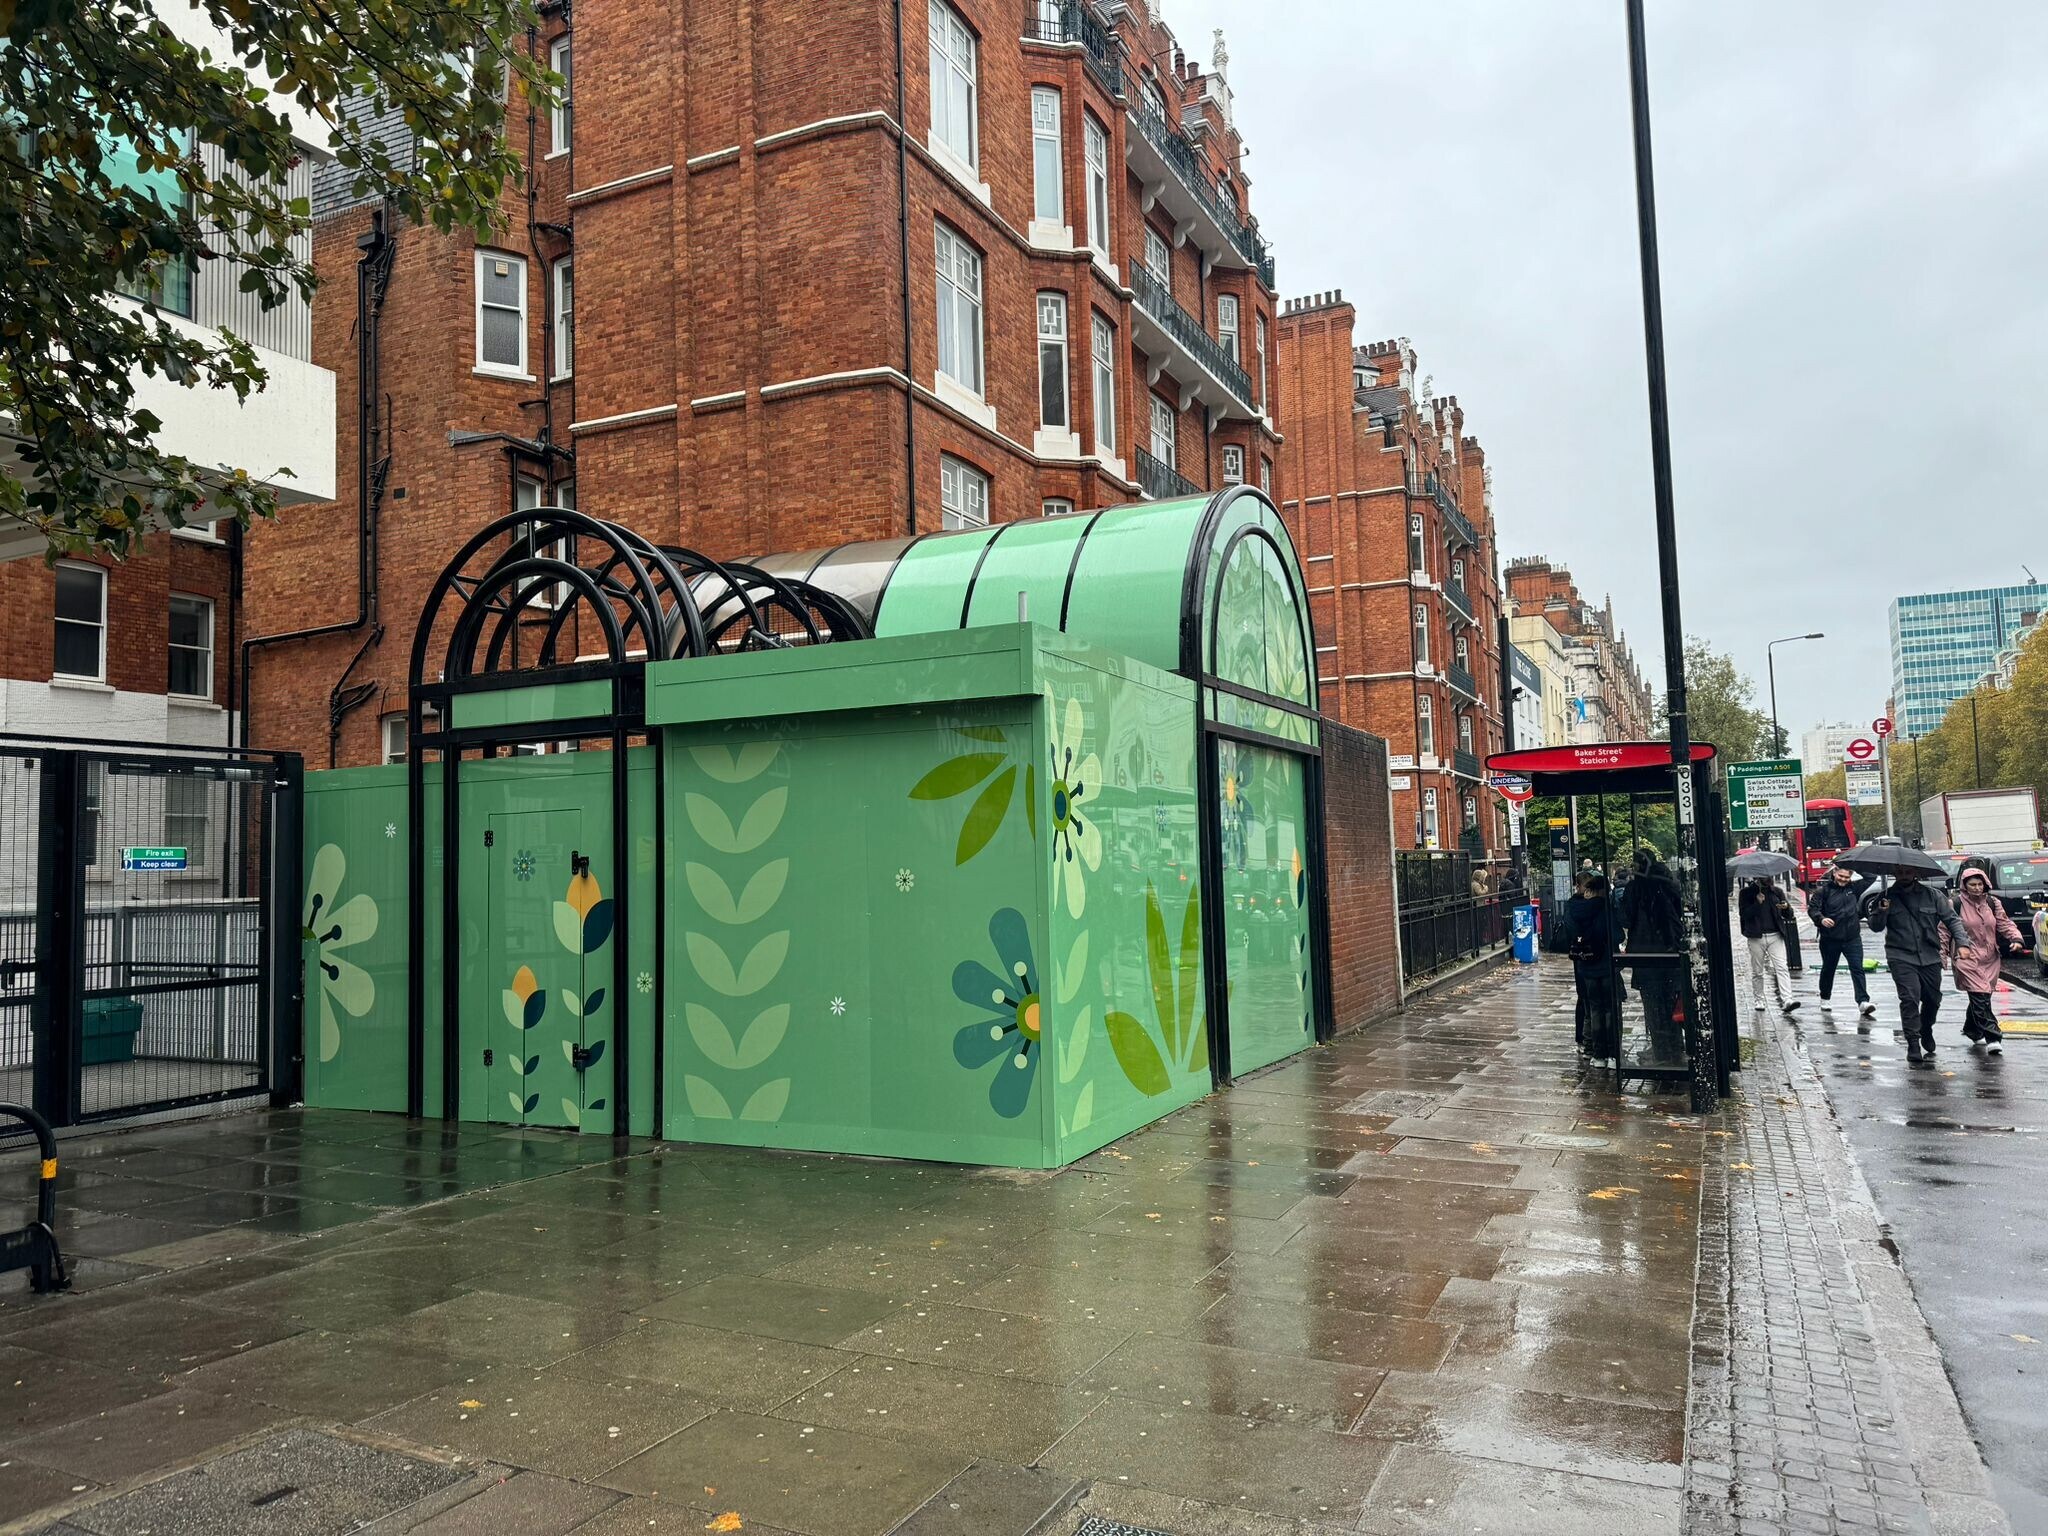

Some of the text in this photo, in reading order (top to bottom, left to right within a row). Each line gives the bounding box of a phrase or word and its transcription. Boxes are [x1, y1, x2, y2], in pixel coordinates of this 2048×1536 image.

[1877, 720, 1886, 732] E
[1574, 748, 1623, 757] Baker Street
[1579, 757, 1608, 765] Station
